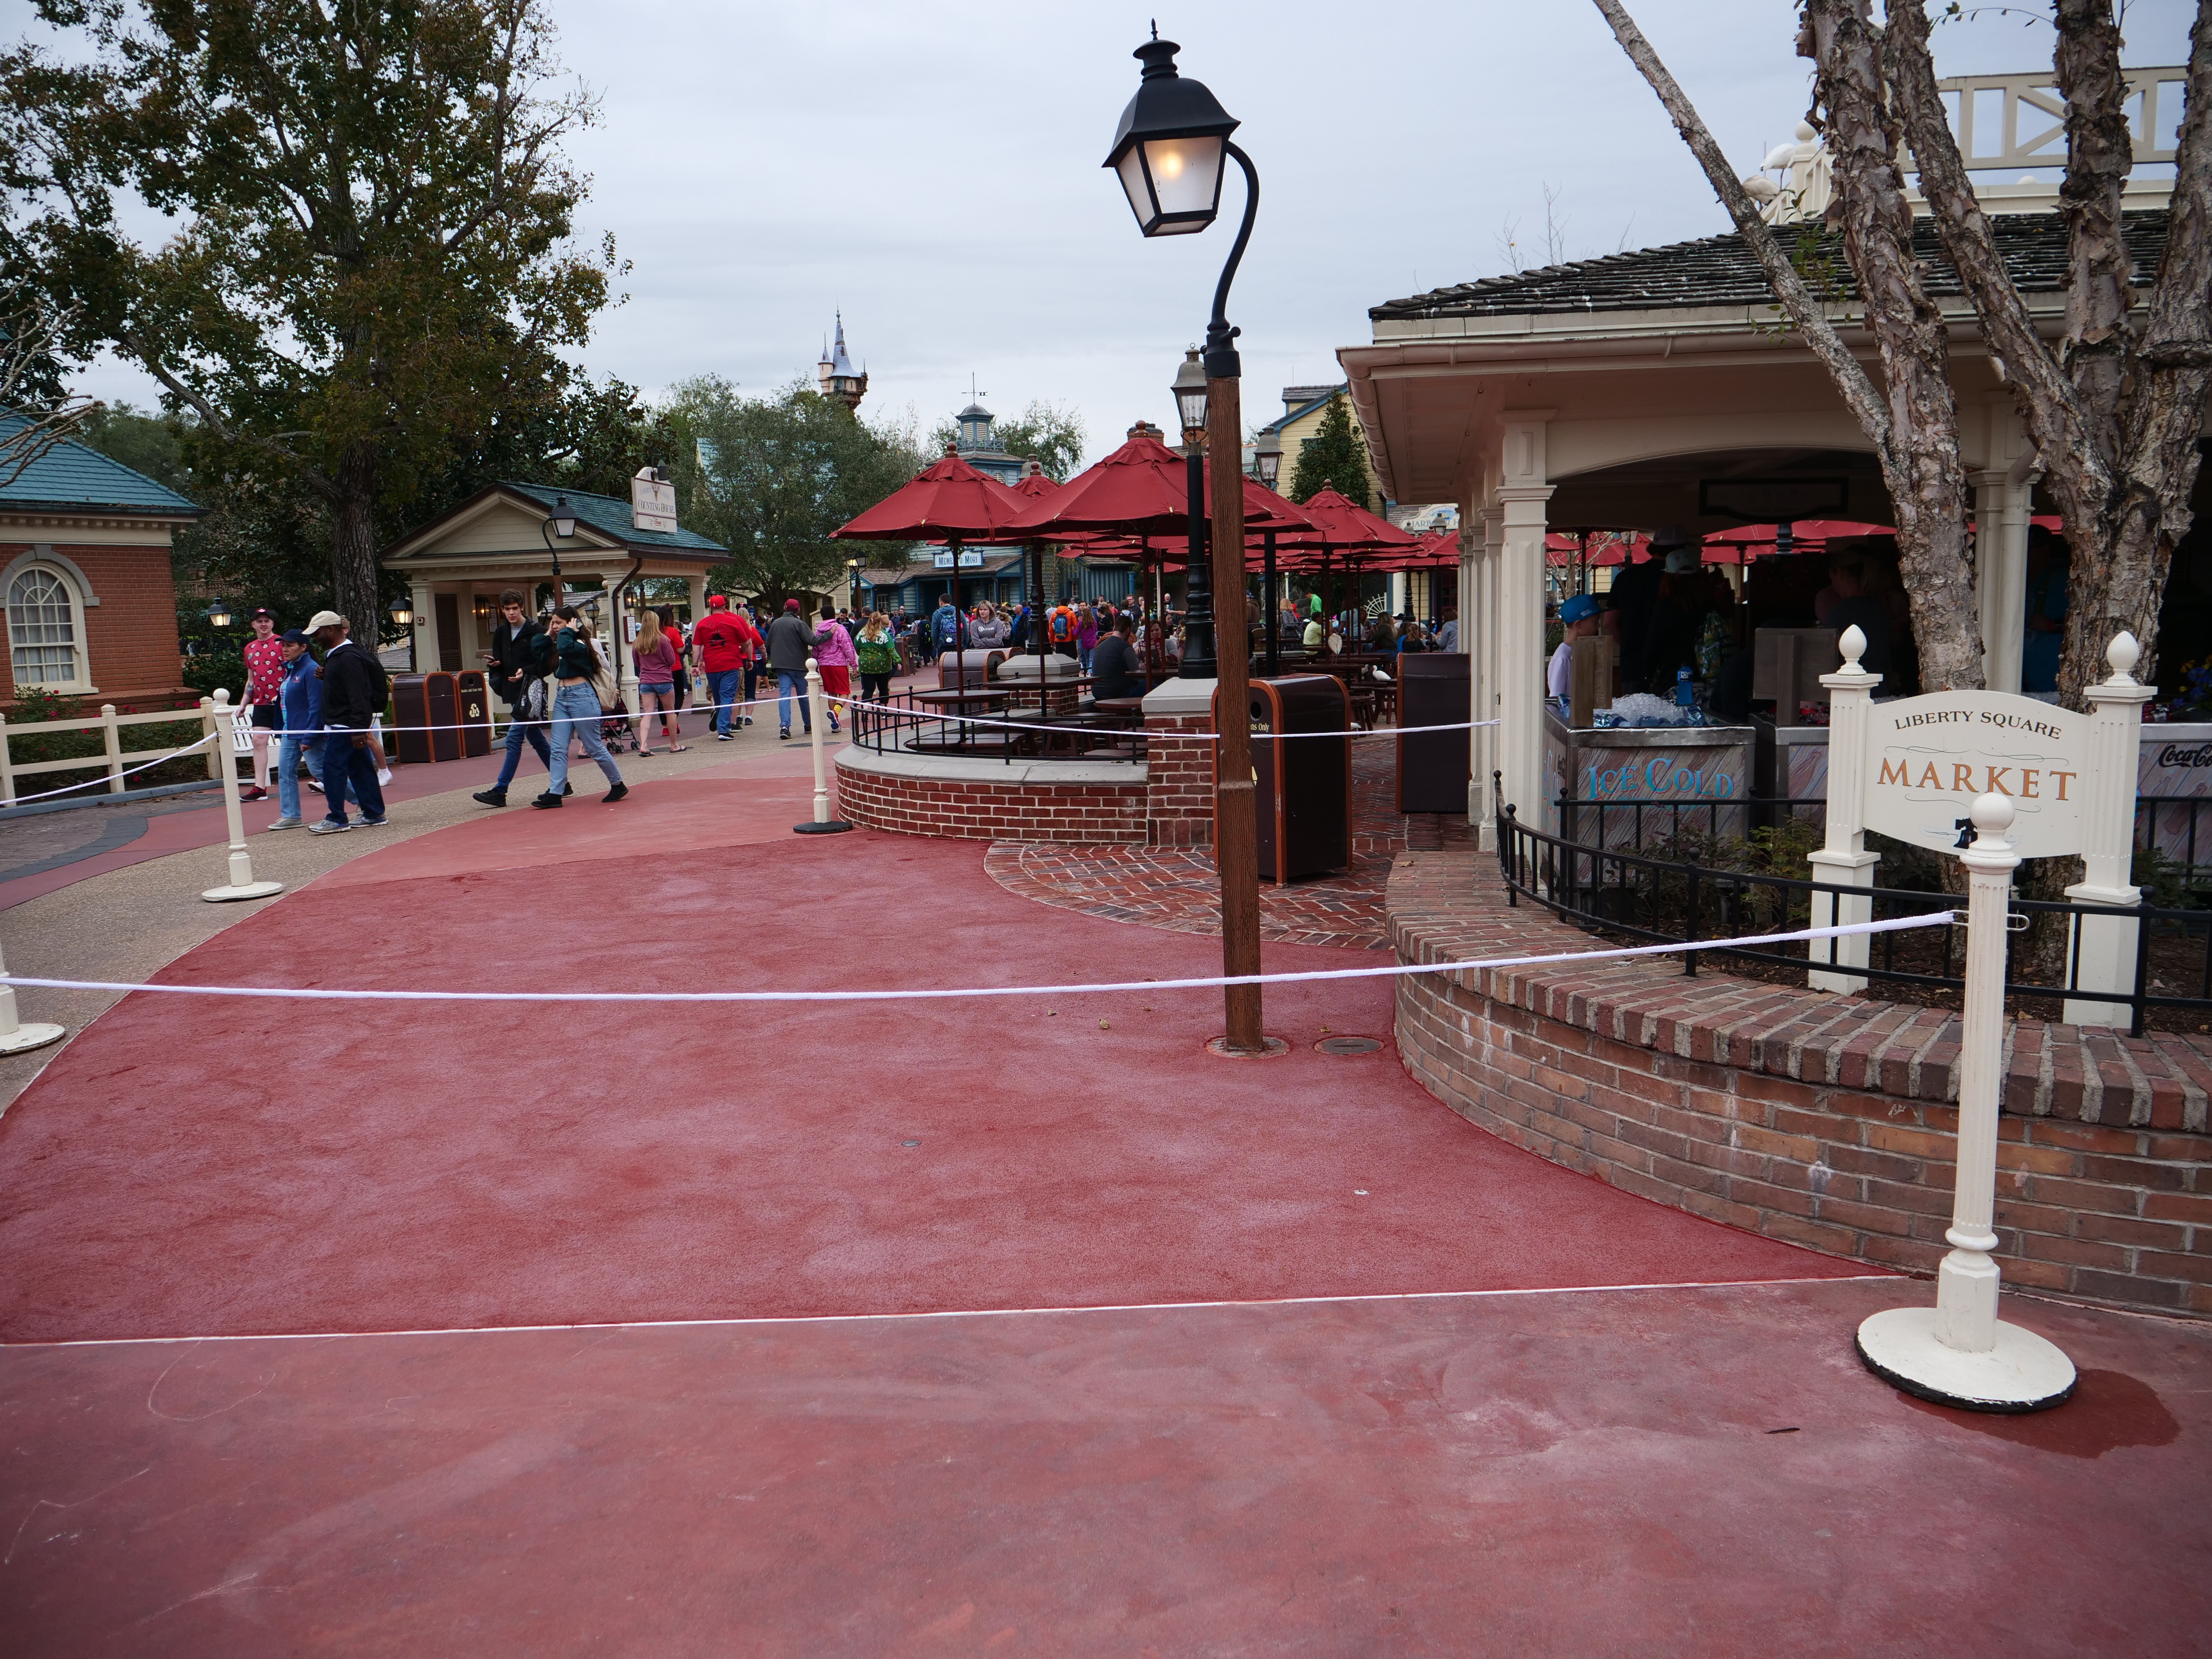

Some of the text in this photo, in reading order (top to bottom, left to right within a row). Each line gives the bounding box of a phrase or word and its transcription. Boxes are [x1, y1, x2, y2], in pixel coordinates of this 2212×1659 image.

[638, 499, 661, 512] COUNTING
[939, 555, 978, 565] MEMEO MORI
[1258, 723, 1269, 733] Only
[1895, 711, 2061, 739] LIBERTY SQUARE
[1877, 757, 2077, 801] MARKET
